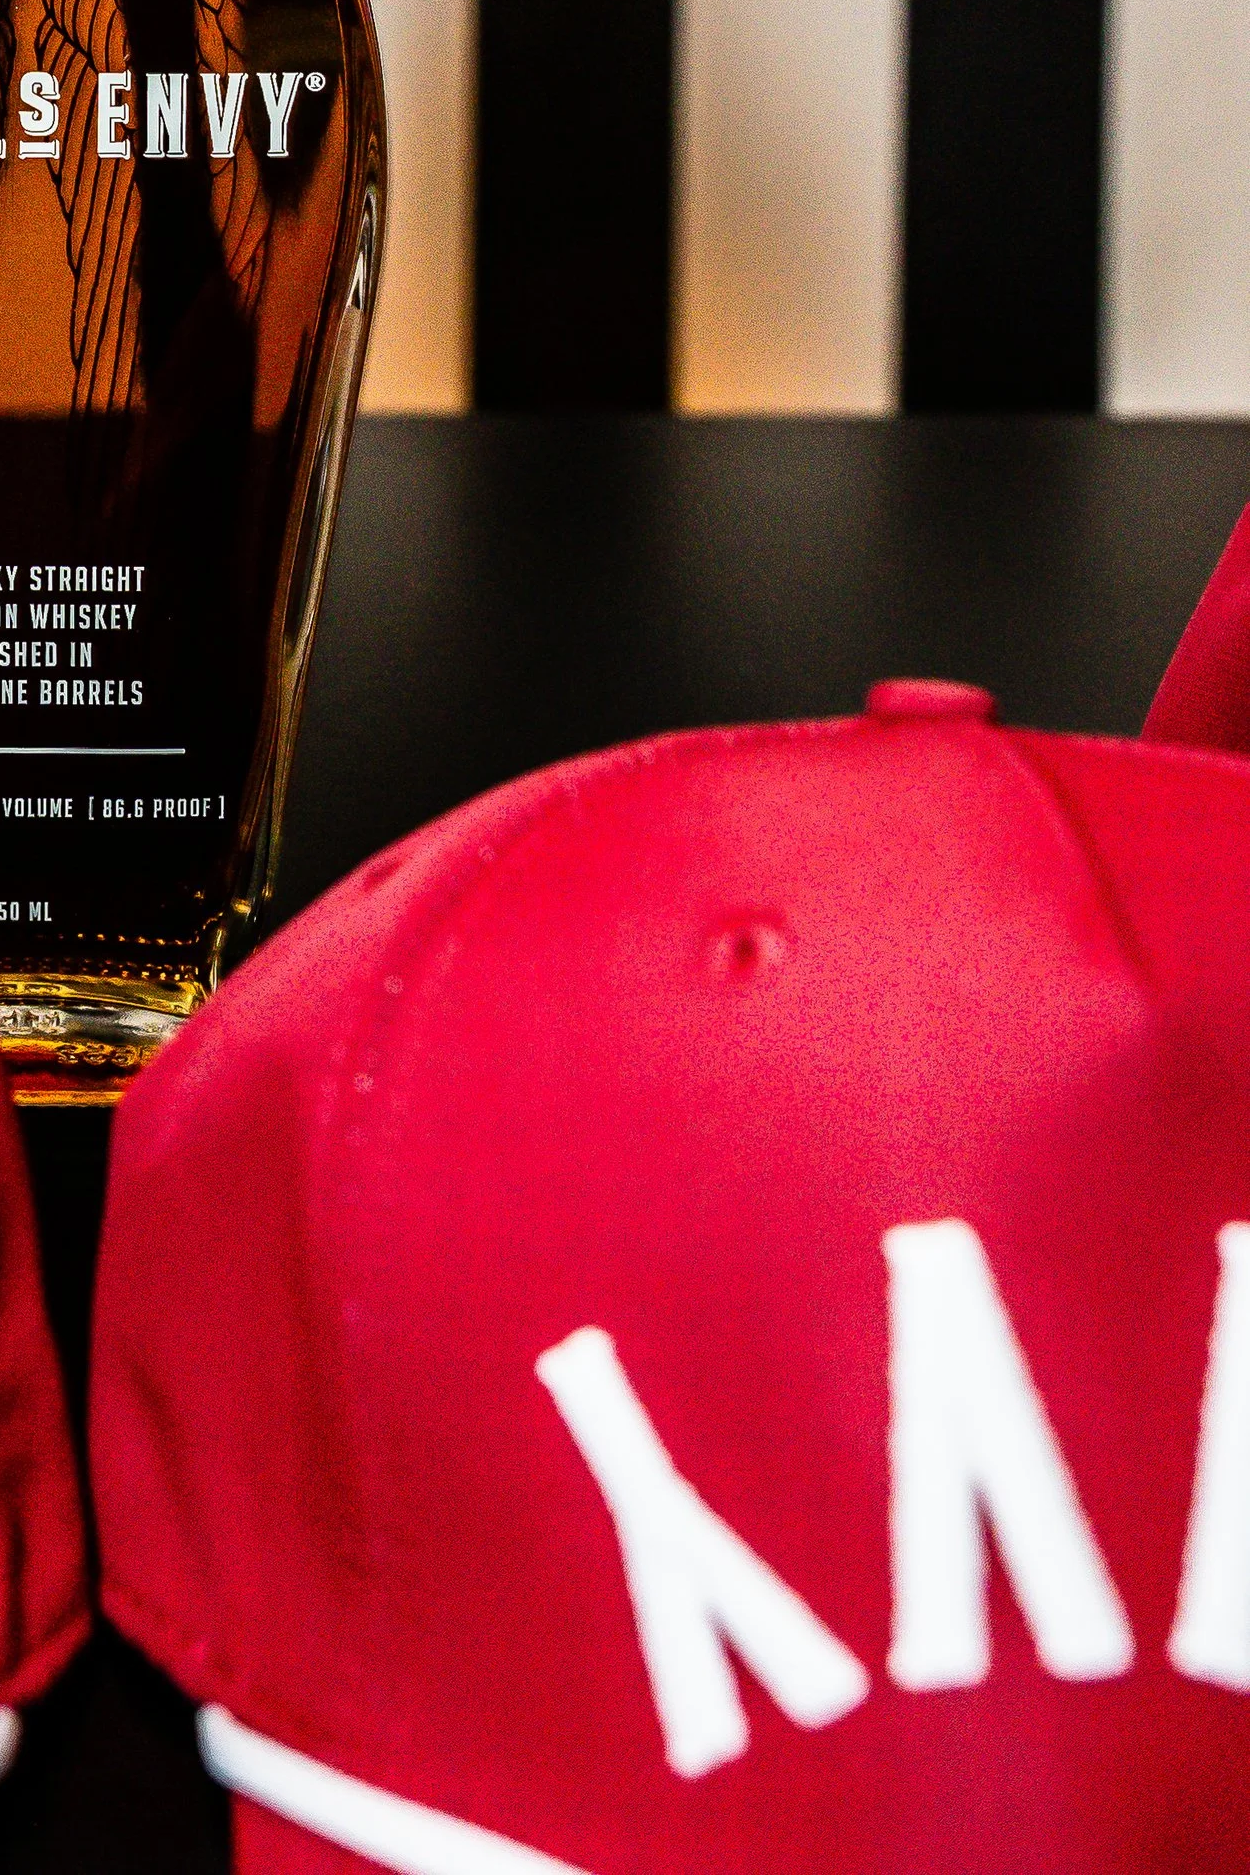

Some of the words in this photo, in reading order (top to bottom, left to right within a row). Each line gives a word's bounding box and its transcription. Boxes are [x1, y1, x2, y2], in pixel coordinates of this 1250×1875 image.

[29, 565, 145, 592] STRAIGHT
[29, 603, 137, 630] WHISKEY
[70, 641, 93, 668] IN
[39, 679, 143, 706] BARRELS
[2, 797, 74, 818] VOLUME
[29, 901, 52, 922] ML
